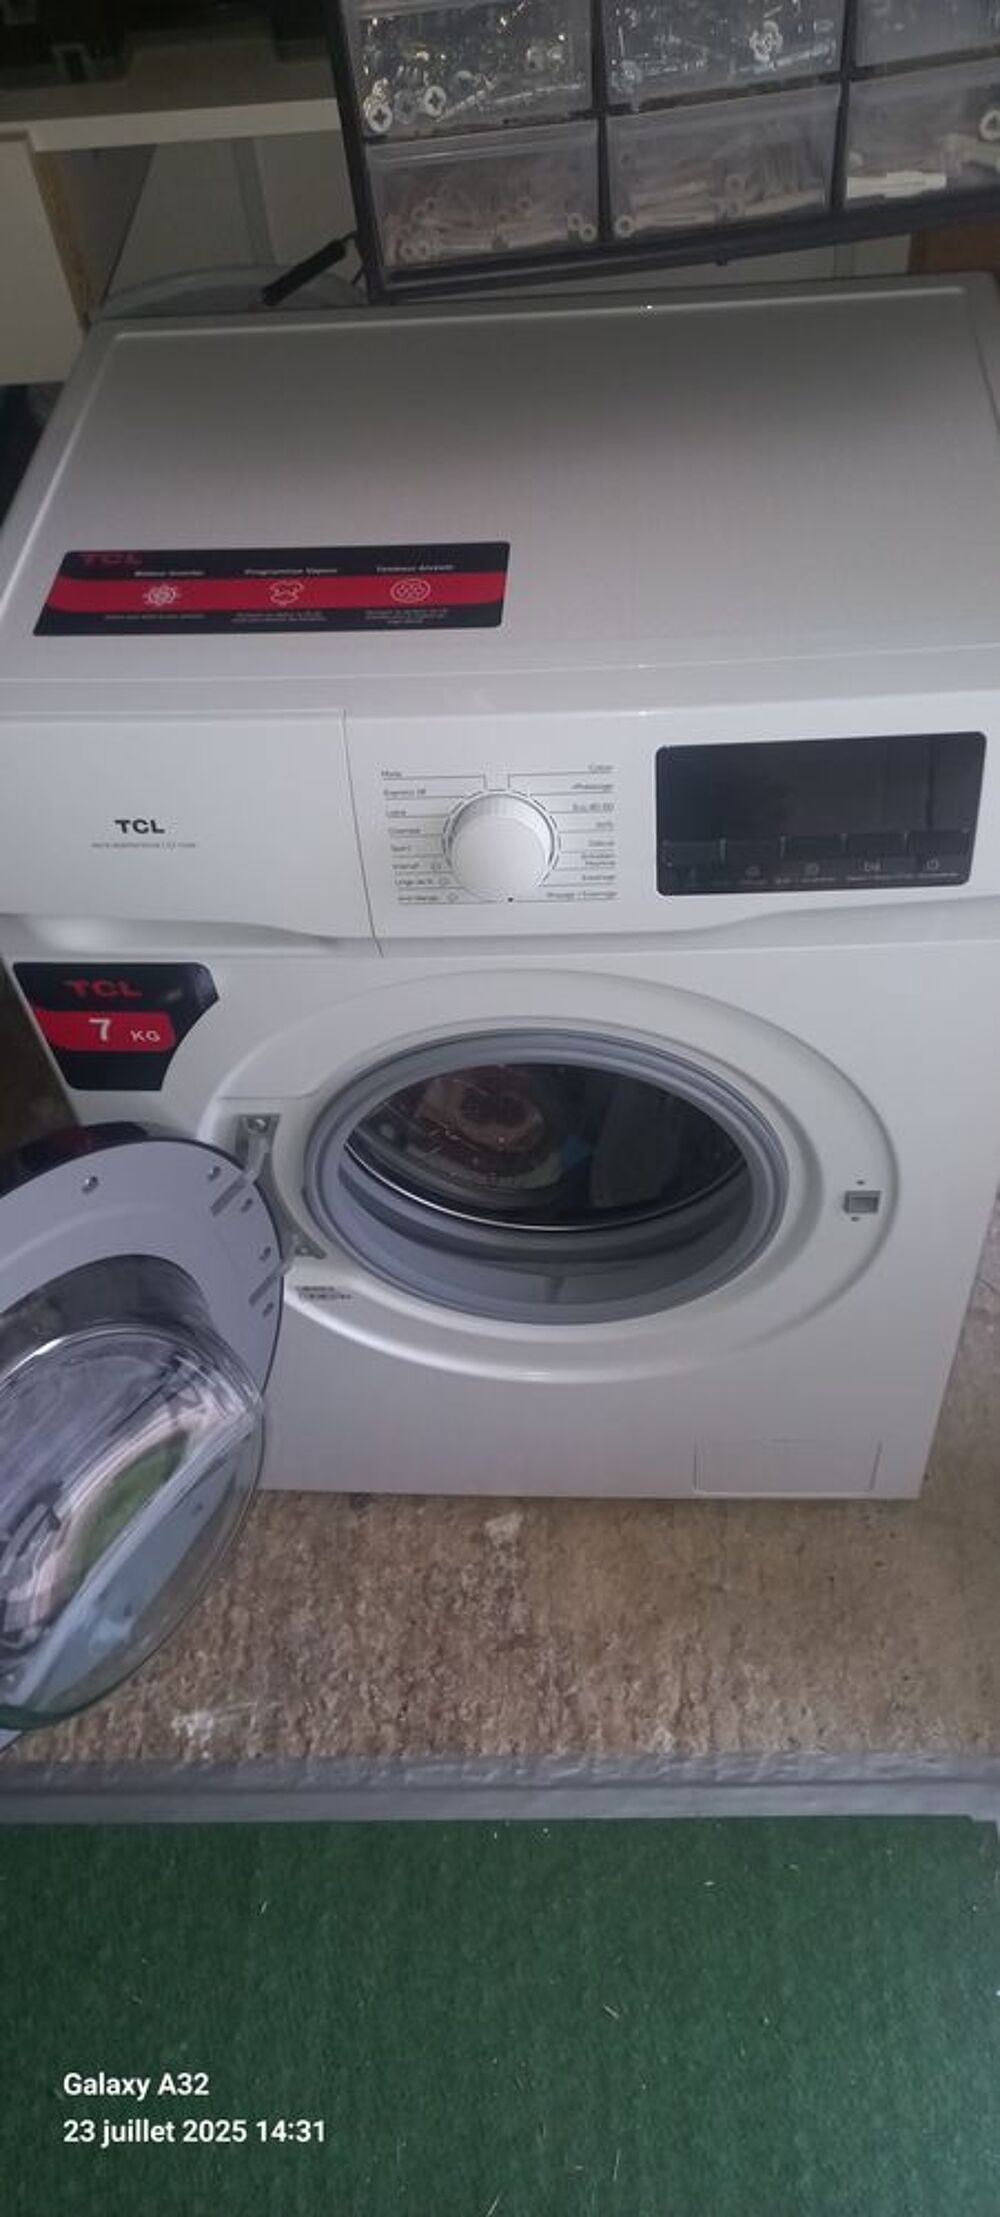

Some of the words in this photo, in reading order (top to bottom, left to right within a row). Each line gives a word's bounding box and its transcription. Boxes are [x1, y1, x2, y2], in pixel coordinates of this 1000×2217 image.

[78, 552, 143, 566] TCL
[113, 818, 166, 834] TCL
[63, 979, 142, 998] TCL
[88, 1017, 112, 1042] 7
[130, 1030, 161, 1043] KG
